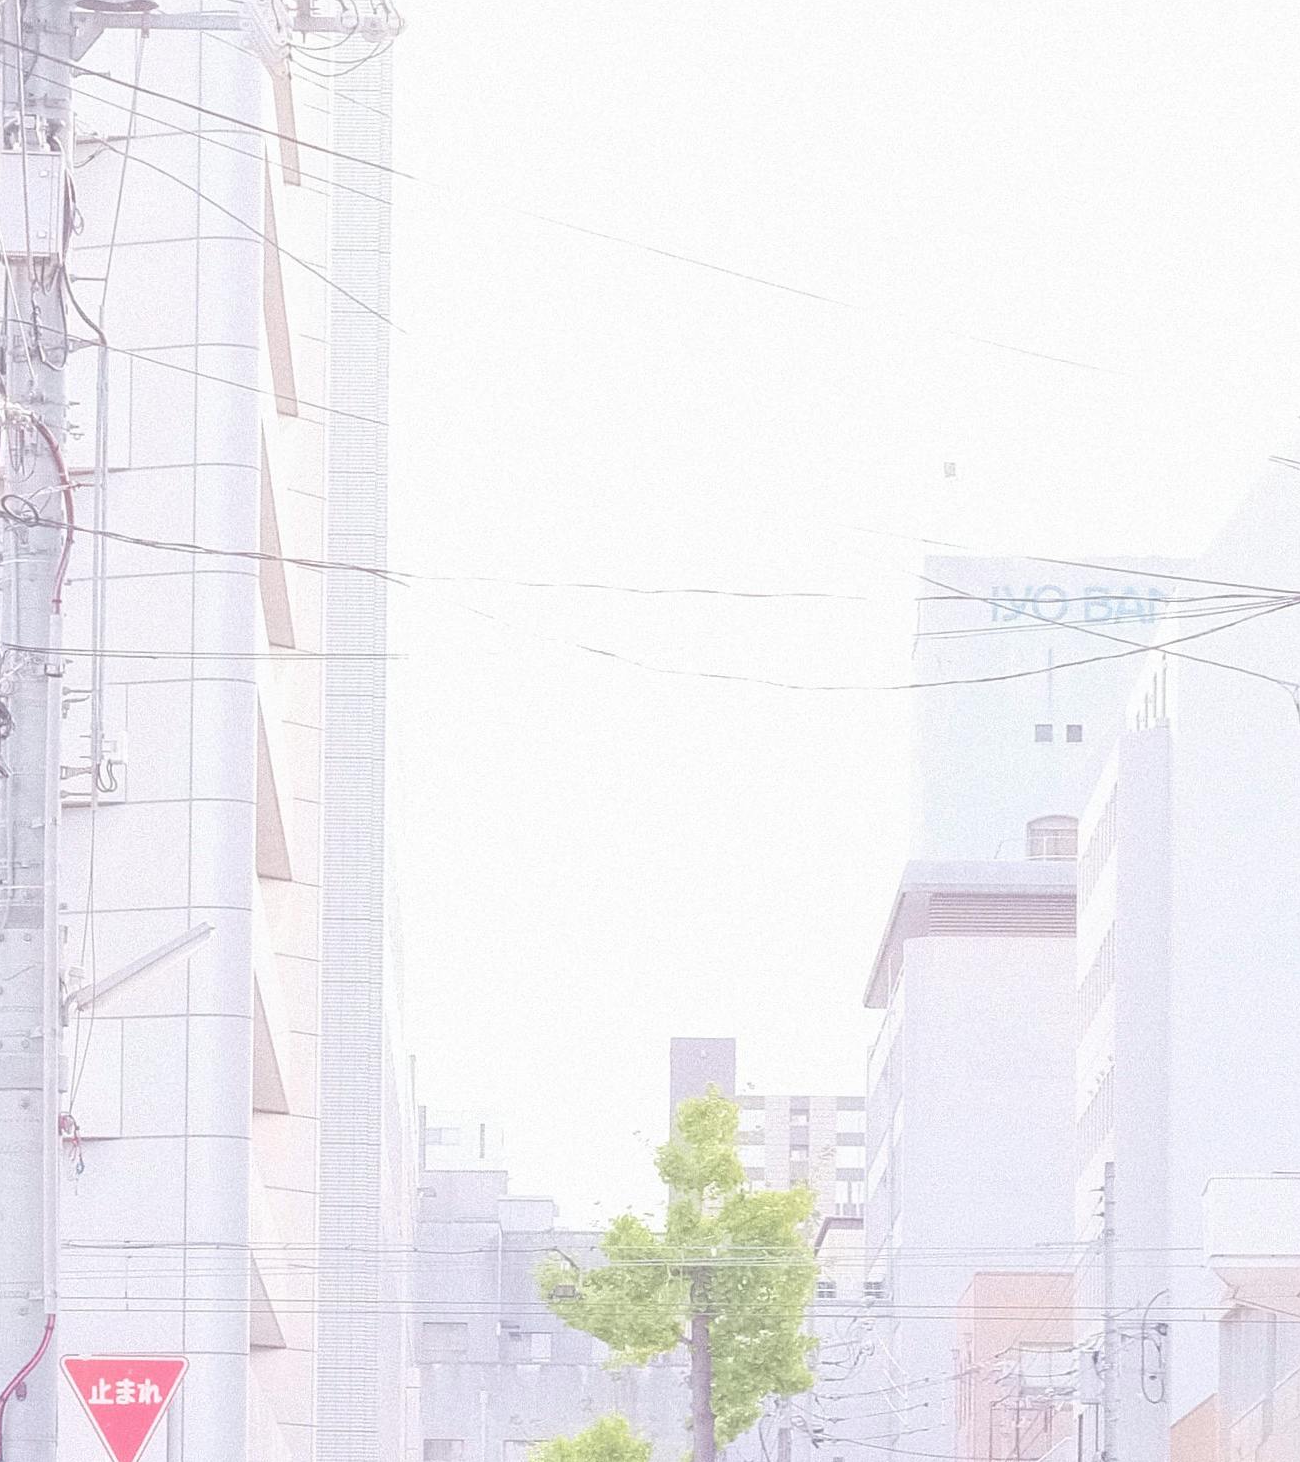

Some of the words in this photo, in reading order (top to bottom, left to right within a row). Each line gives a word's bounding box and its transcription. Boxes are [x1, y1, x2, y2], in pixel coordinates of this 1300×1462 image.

[990, 584, 1068, 623] IYO
[88, 1379, 163, 1406] 止まれ
